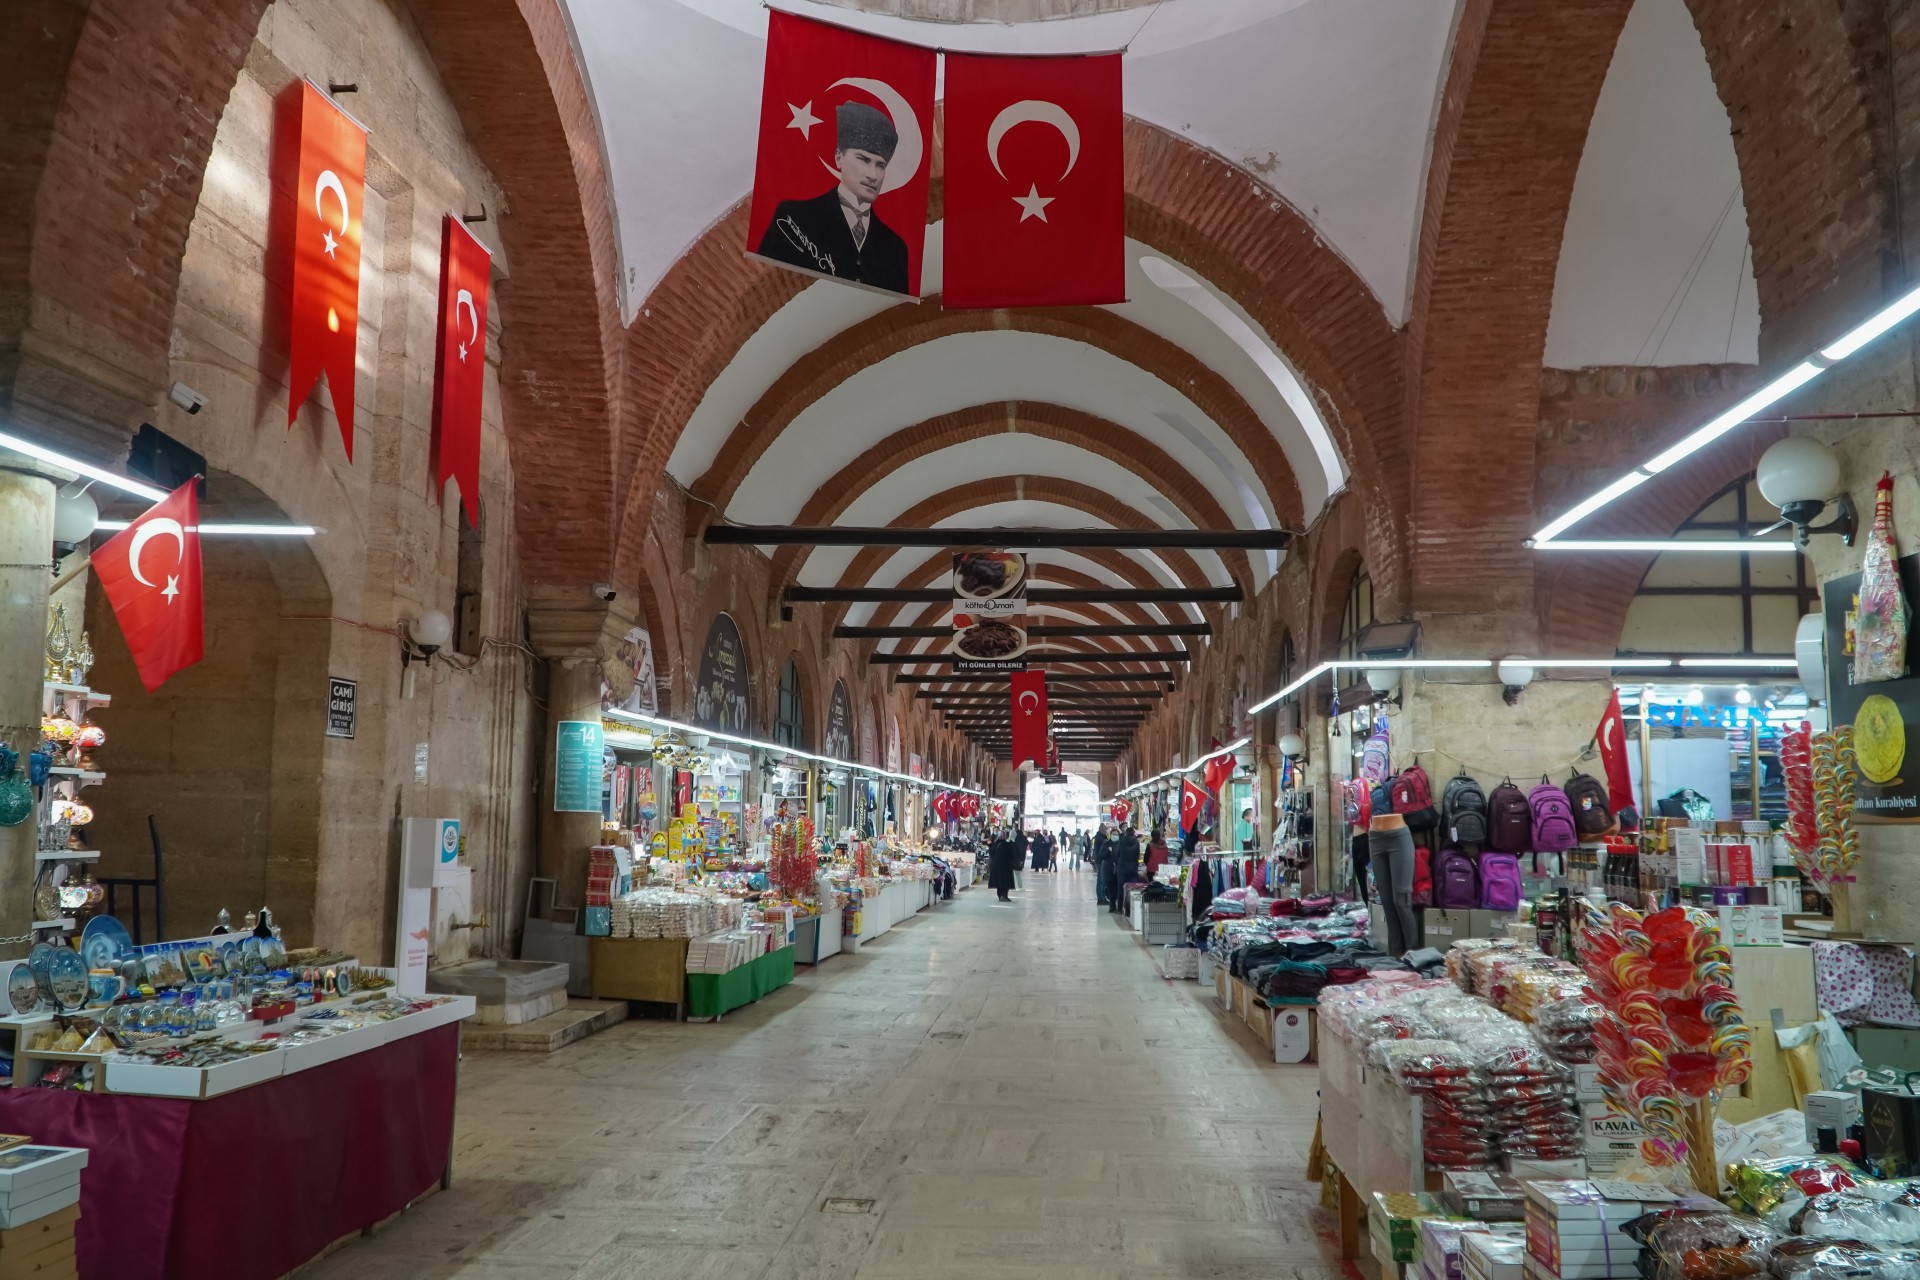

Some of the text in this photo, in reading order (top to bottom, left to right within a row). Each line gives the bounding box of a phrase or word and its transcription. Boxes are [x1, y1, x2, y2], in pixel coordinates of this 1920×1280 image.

[958, 661, 1023, 669] İYİ GÜNLER DİLERİZ
[333, 685, 353, 699] CAMİ
[330, 698, 354, 715] GİRİŞİ
[1646, 699, 1772, 728] SİNAN
[579, 725, 595, 744] 14
[1854, 795, 1917, 811] ultan Kurabiyesi
[1594, 1121, 1638, 1131] KAVAL
